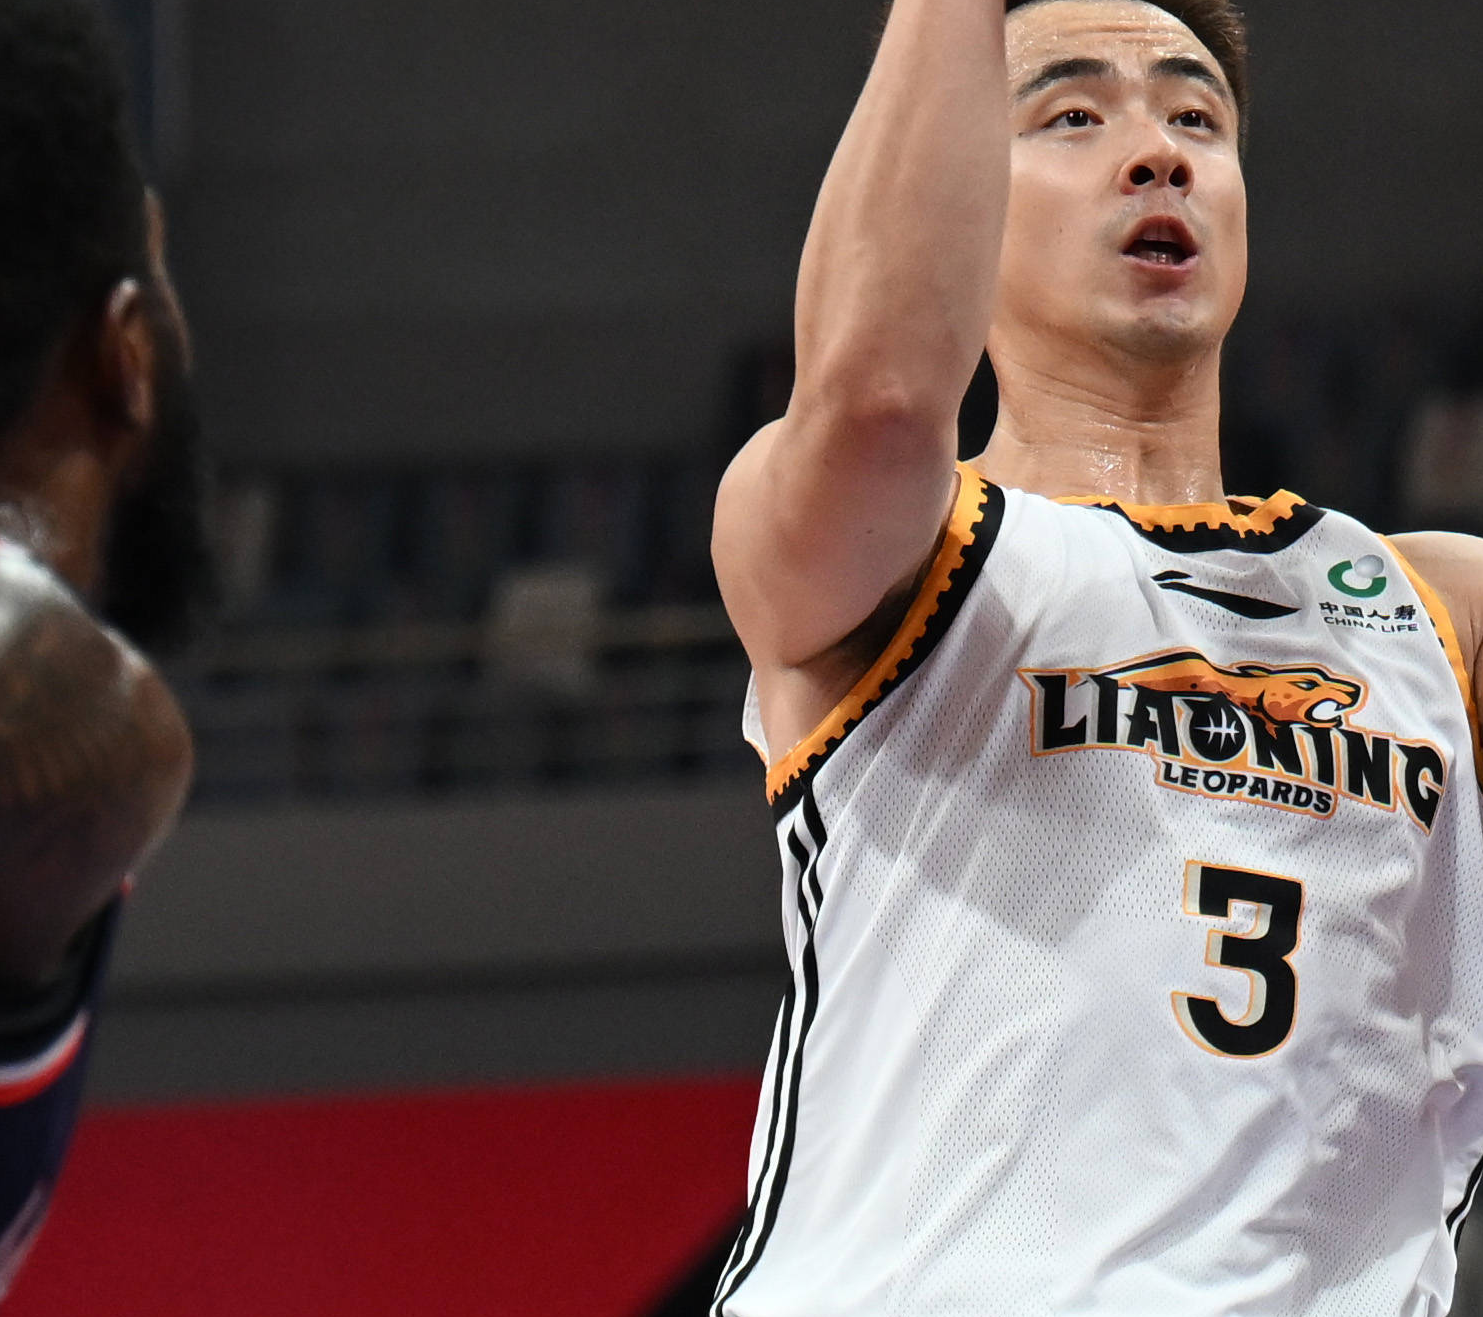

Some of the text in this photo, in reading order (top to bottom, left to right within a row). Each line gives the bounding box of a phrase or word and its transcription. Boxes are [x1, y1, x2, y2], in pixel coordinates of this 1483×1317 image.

[1323, 616, 1419, 633] CHINA LIFE
[1020, 665, 1450, 834] LIAONING
[1159, 760, 1334, 816] LEOPARDS
[1170, 859, 1306, 1059] 3
